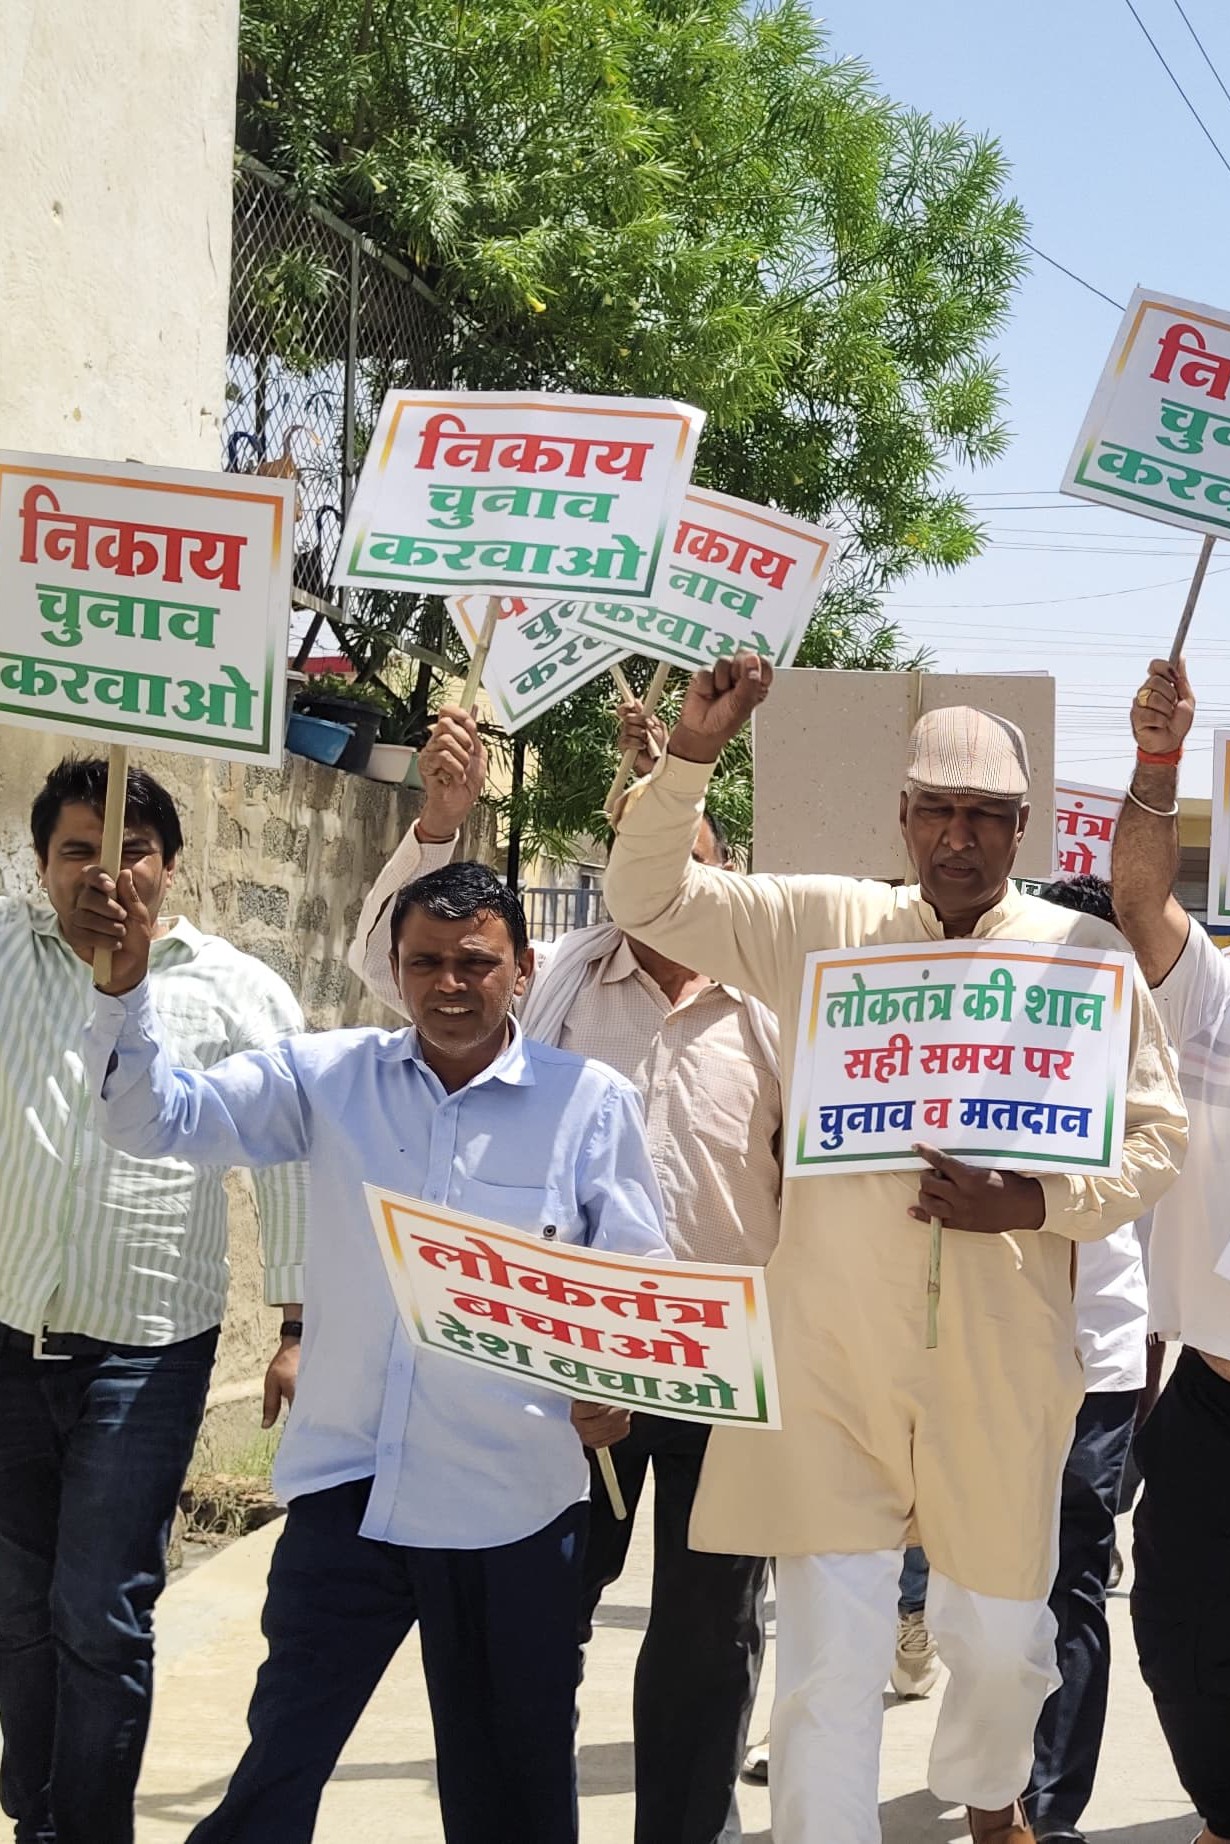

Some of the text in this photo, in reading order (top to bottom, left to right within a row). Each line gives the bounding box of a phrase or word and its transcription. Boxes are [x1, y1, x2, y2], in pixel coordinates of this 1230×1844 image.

[415, 413, 654, 481] निकाय
[19, 485, 247, 591] निकाय
[427, 484, 620, 529] चुनाव
[369, 534, 647, 581] करवाओ
[36, 583, 220, 648] चुनाव
[0, 652, 258, 730] करवाओ
[827, 968, 1106, 1032] लोकतंत्र की शान
[844, 1033, 1075, 1083] सही समय पर
[819, 1098, 1092, 1150] चुनाव व मतदान
[410, 1233, 730, 1330] लोकतंत्र
[435, 1310, 739, 1410] देश बचाओ
[445, 1287, 710, 1369] बचाओ
